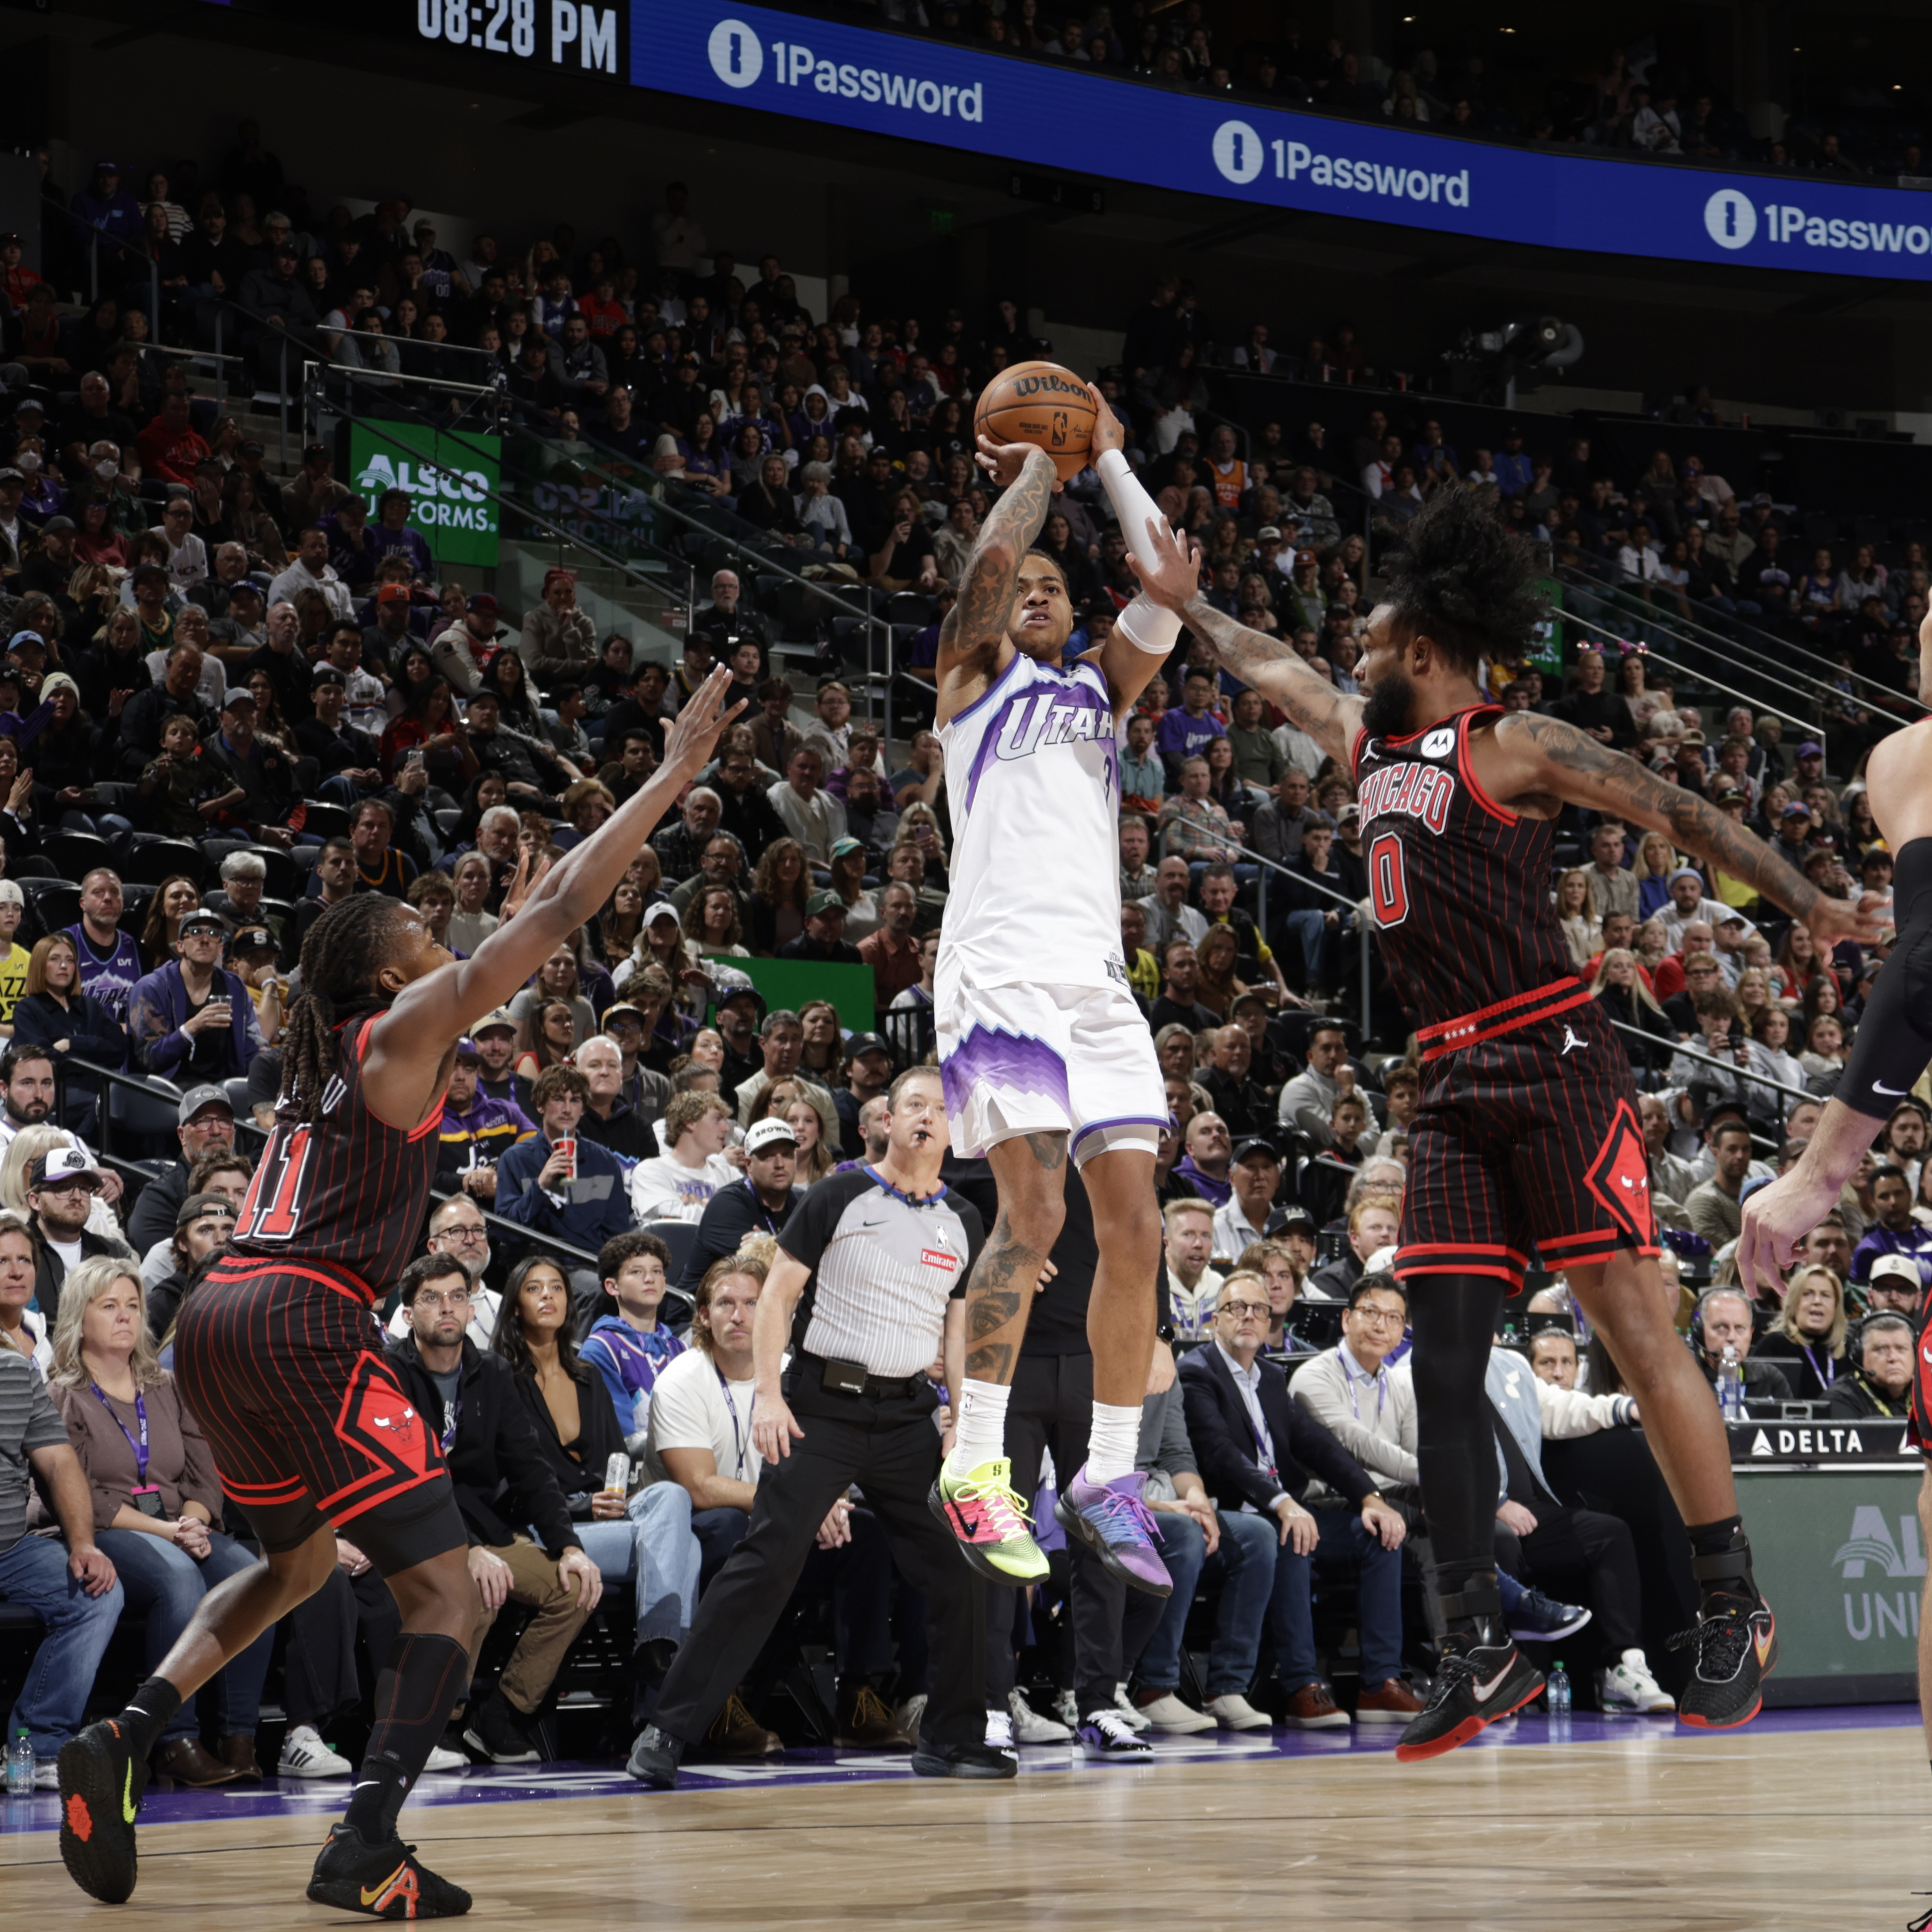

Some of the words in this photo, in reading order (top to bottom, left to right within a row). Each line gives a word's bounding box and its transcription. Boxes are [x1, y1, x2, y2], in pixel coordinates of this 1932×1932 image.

[417, 0, 534, 57] 08:28
[551, 0, 616, 74] PM
[772, 41, 983, 122] 1Password
[1272, 139, 1469, 207] 1Password
[1765, 204, 1932, 254] 1Passwo
[1012, 374, 1093, 405] Wilson
[355, 454, 489, 502] ALSCO
[995, 693, 1115, 762] UTAH
[1358, 762, 1455, 839] HICAGO
[1369, 831, 1410, 930] 0
[253, 931, 268, 946] S
[755, 1125, 792, 1138] BROWNS
[232, 1122, 315, 1240] 11
[922, 1250, 956, 1269] Emirates
[1777, 1429, 1864, 1454] DELTA
